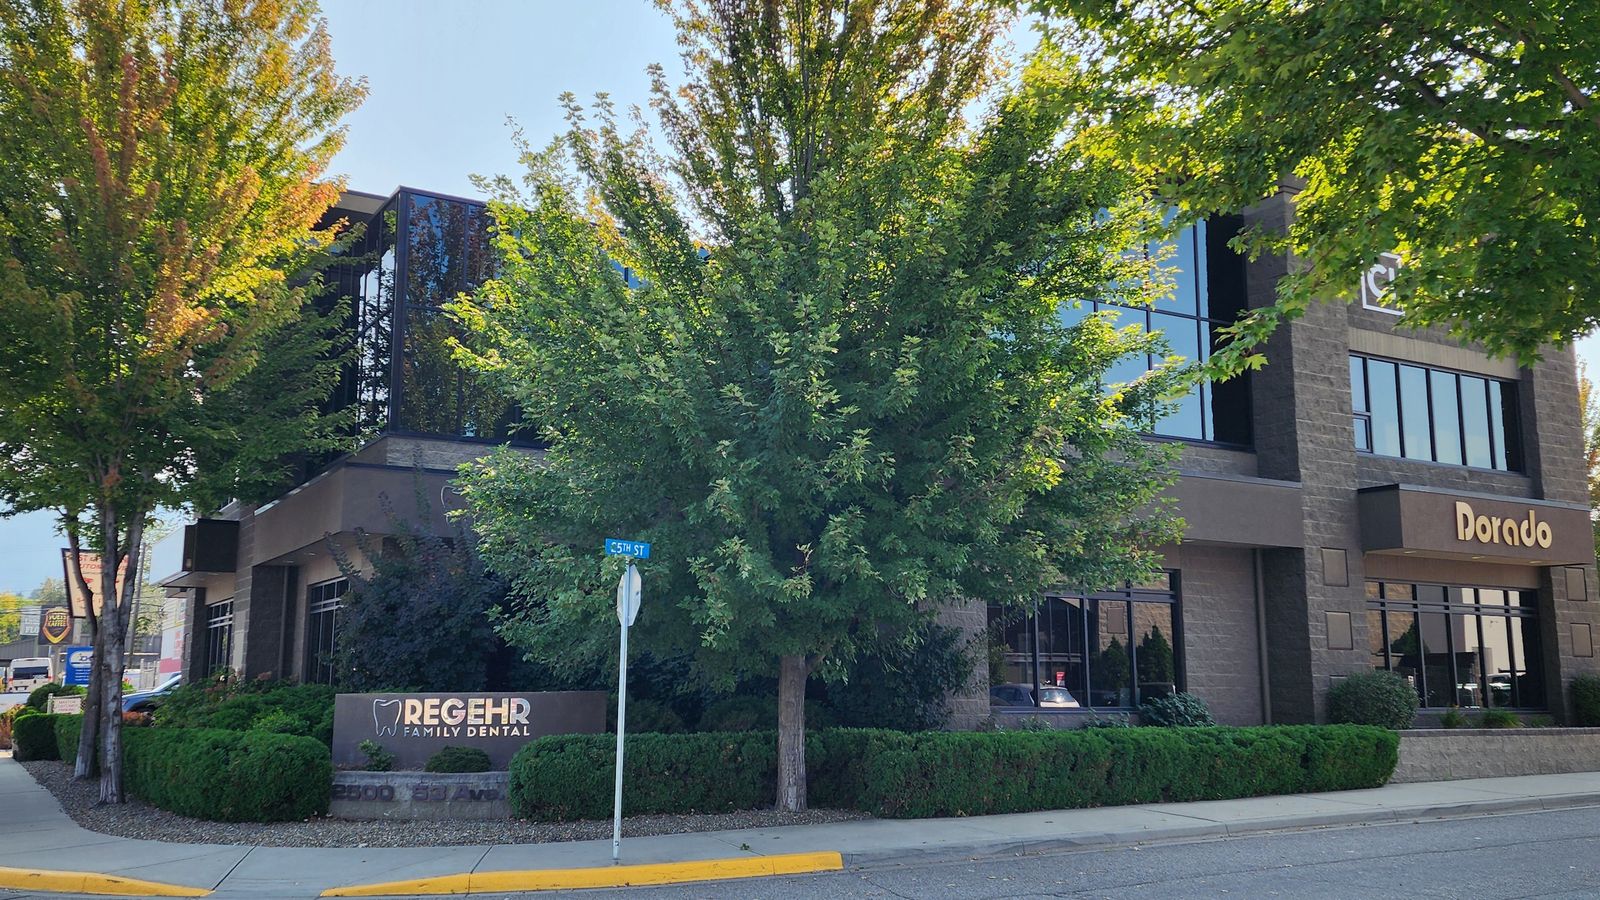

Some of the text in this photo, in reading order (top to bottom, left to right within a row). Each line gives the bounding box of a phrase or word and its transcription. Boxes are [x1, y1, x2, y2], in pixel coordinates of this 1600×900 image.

[1455, 501, 1553, 549] Dorado
[634, 545, 645, 556] ST
[403, 697, 531, 726] REGEHR
[403, 725, 531, 738] FAMILY DENTAL
[331, 784, 395, 802] 2500
[411, 784, 447, 801] 53
